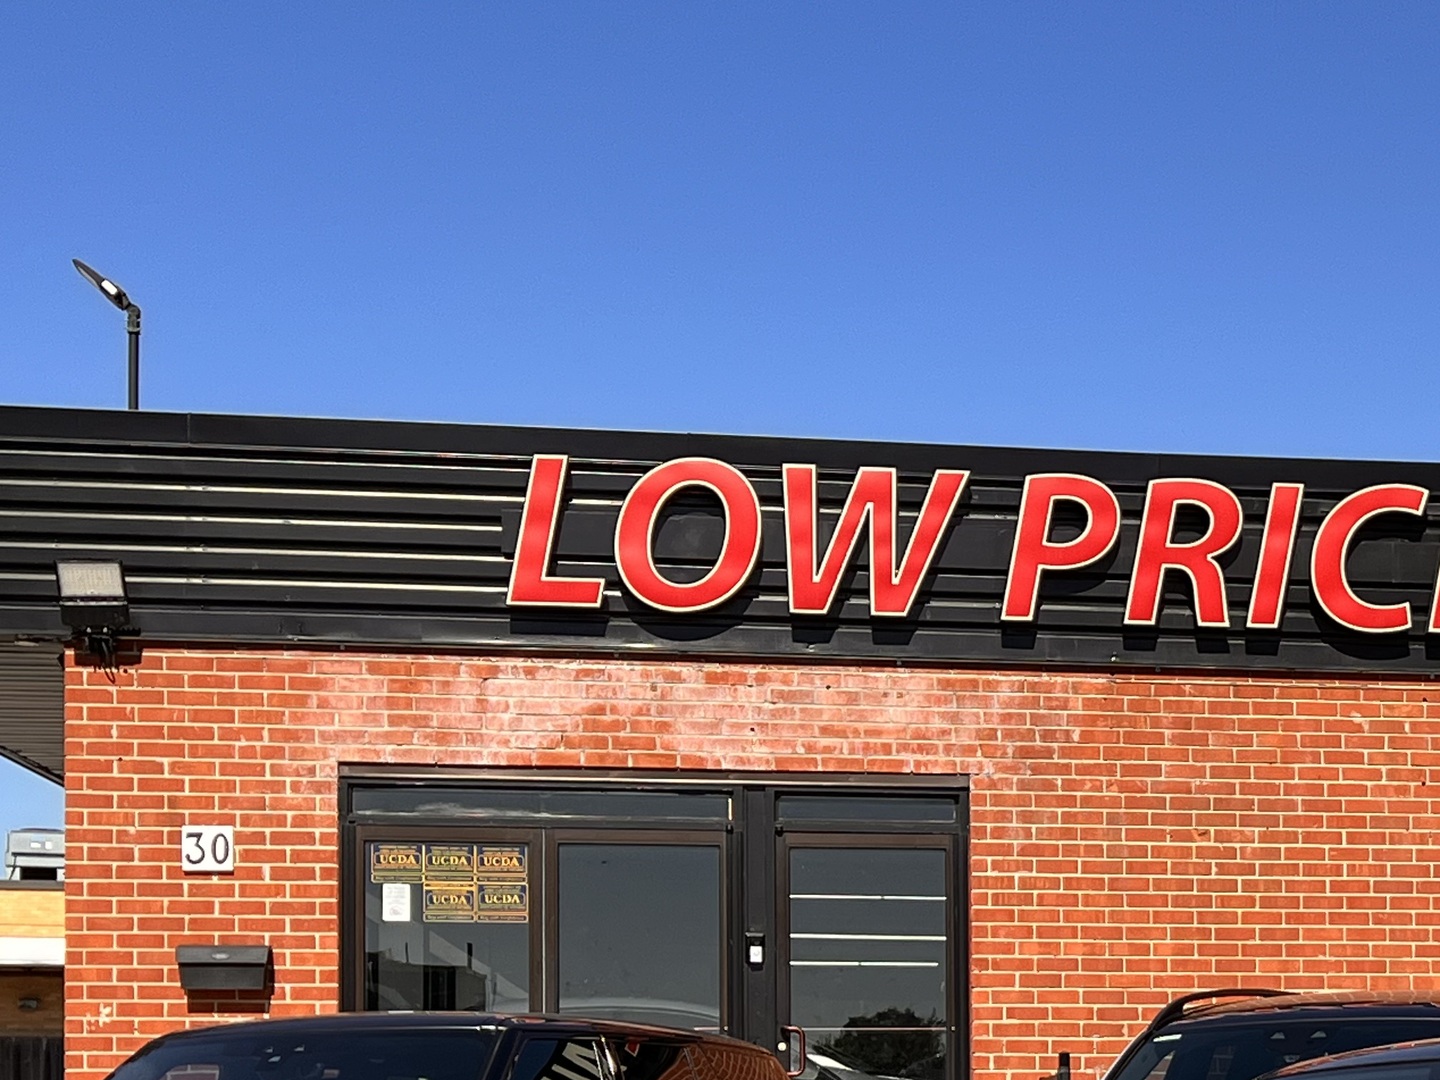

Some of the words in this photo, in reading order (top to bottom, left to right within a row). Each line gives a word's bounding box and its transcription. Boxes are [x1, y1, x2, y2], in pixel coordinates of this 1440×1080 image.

[506, 454, 970, 616] LOW
[185, 832, 230, 865] 30
[379, 854, 417, 864] UCDA
[432, 855, 468, 865] UCDA
[483, 856, 520, 867] UCDA
[433, 894, 468, 905] UCDA
[485, 894, 520, 904] UCDA
